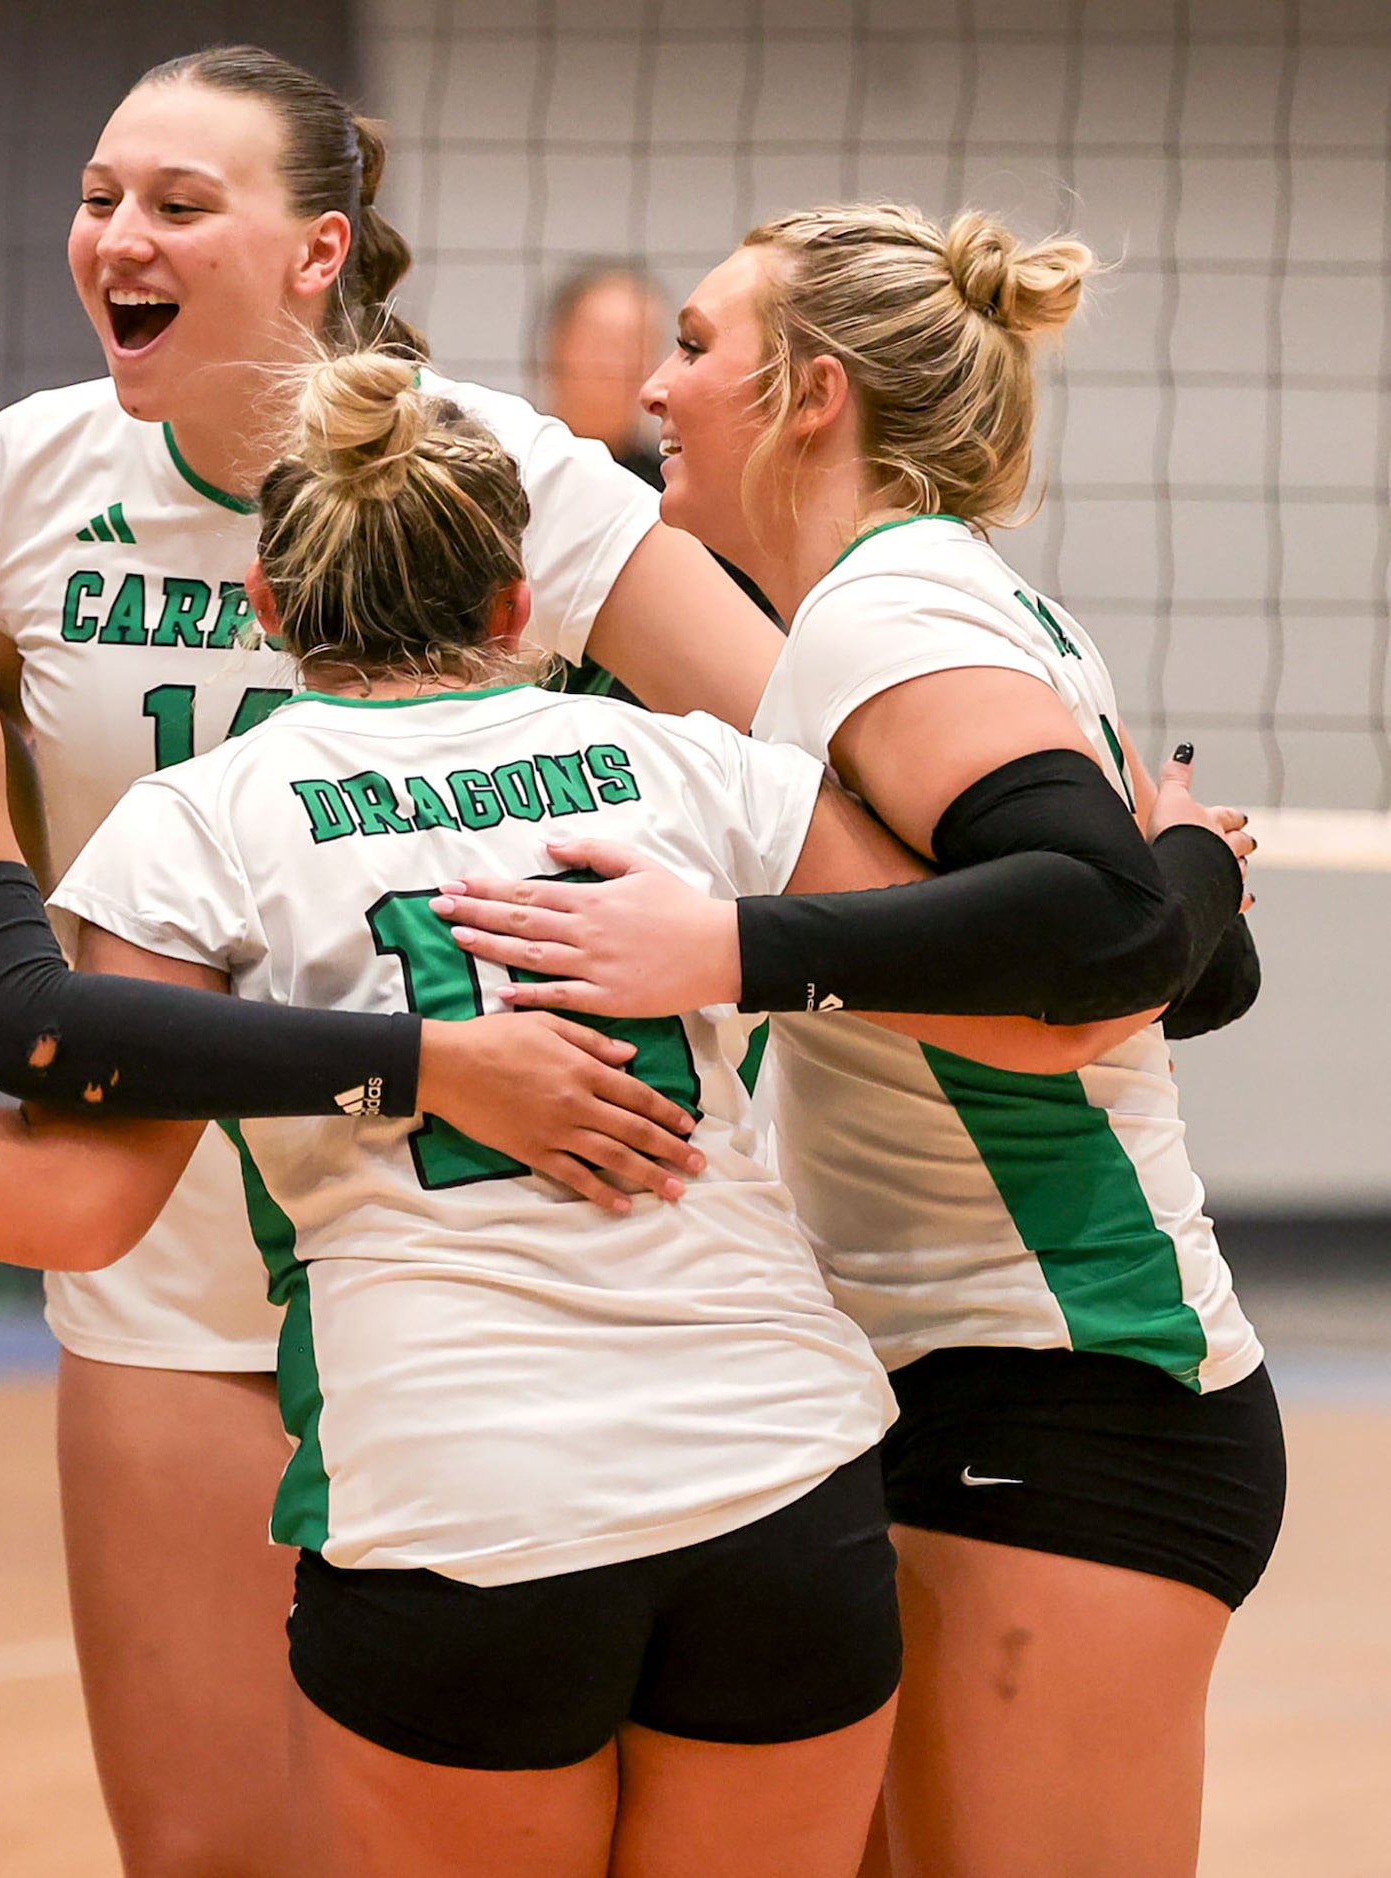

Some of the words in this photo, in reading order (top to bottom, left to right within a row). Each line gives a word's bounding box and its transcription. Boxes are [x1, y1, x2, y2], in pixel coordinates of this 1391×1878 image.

[60, 570, 292, 652] CARR
[142, 683, 294, 772] 1
[290, 744, 642, 844] DRAGONS
